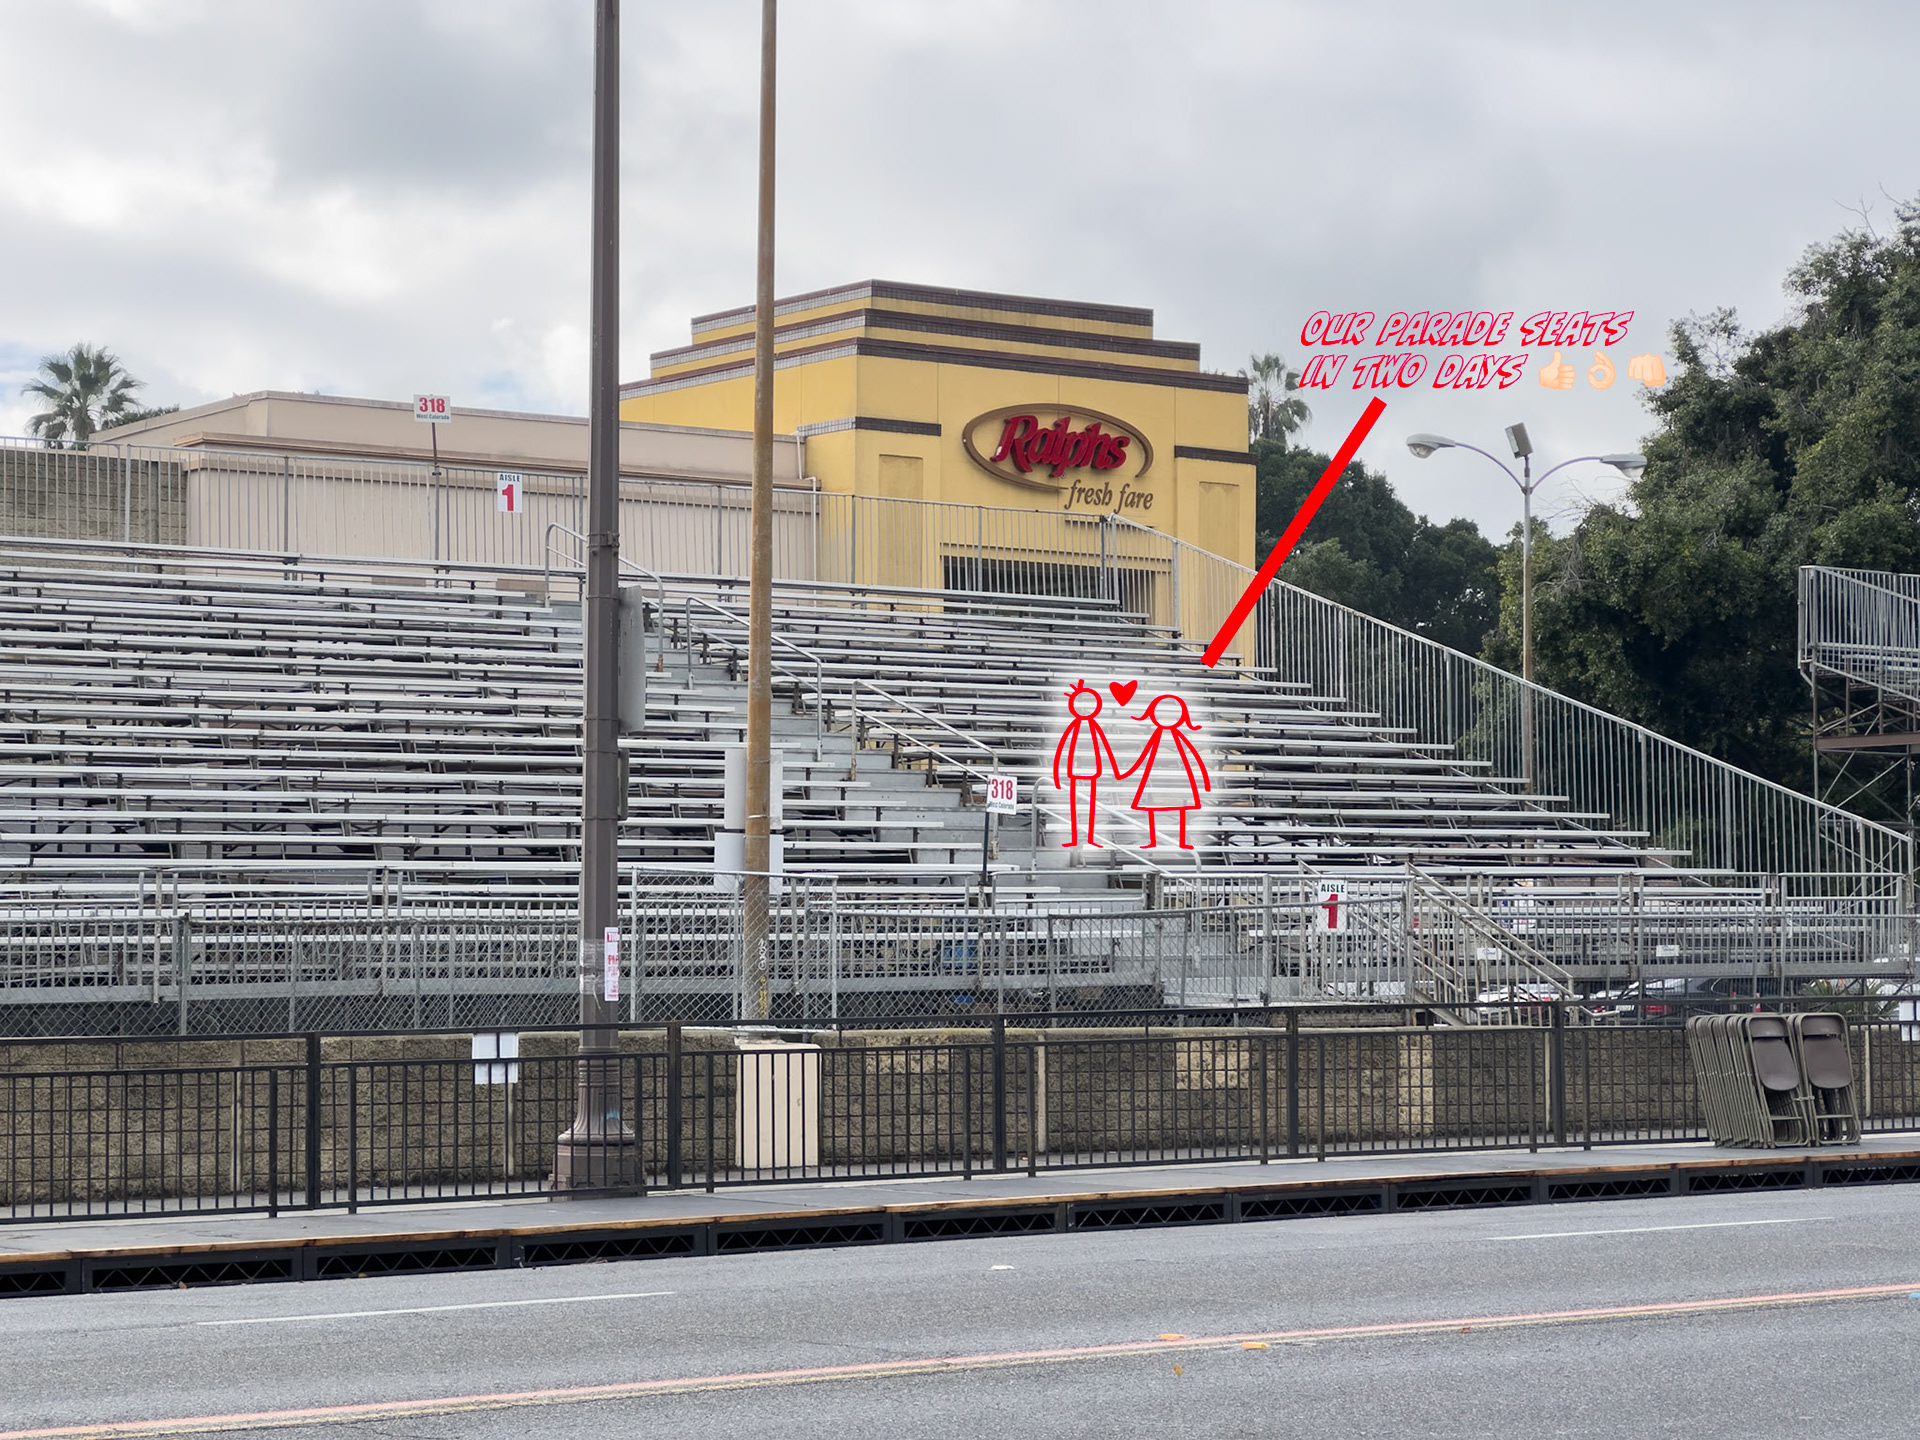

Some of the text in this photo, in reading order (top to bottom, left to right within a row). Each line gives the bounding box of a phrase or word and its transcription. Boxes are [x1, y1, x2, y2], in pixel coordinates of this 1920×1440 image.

[419, 397, 445, 413] 318
[990, 415, 1131, 478] Ralphs
[499, 473, 521, 482] AISLE
[502, 484, 514, 512] 1
[1064, 479, 1154, 514] fresh fare
[991, 778, 1013, 800] 318
[1321, 883, 1345, 893] AISLE
[1321, 894, 1338, 929] 1
